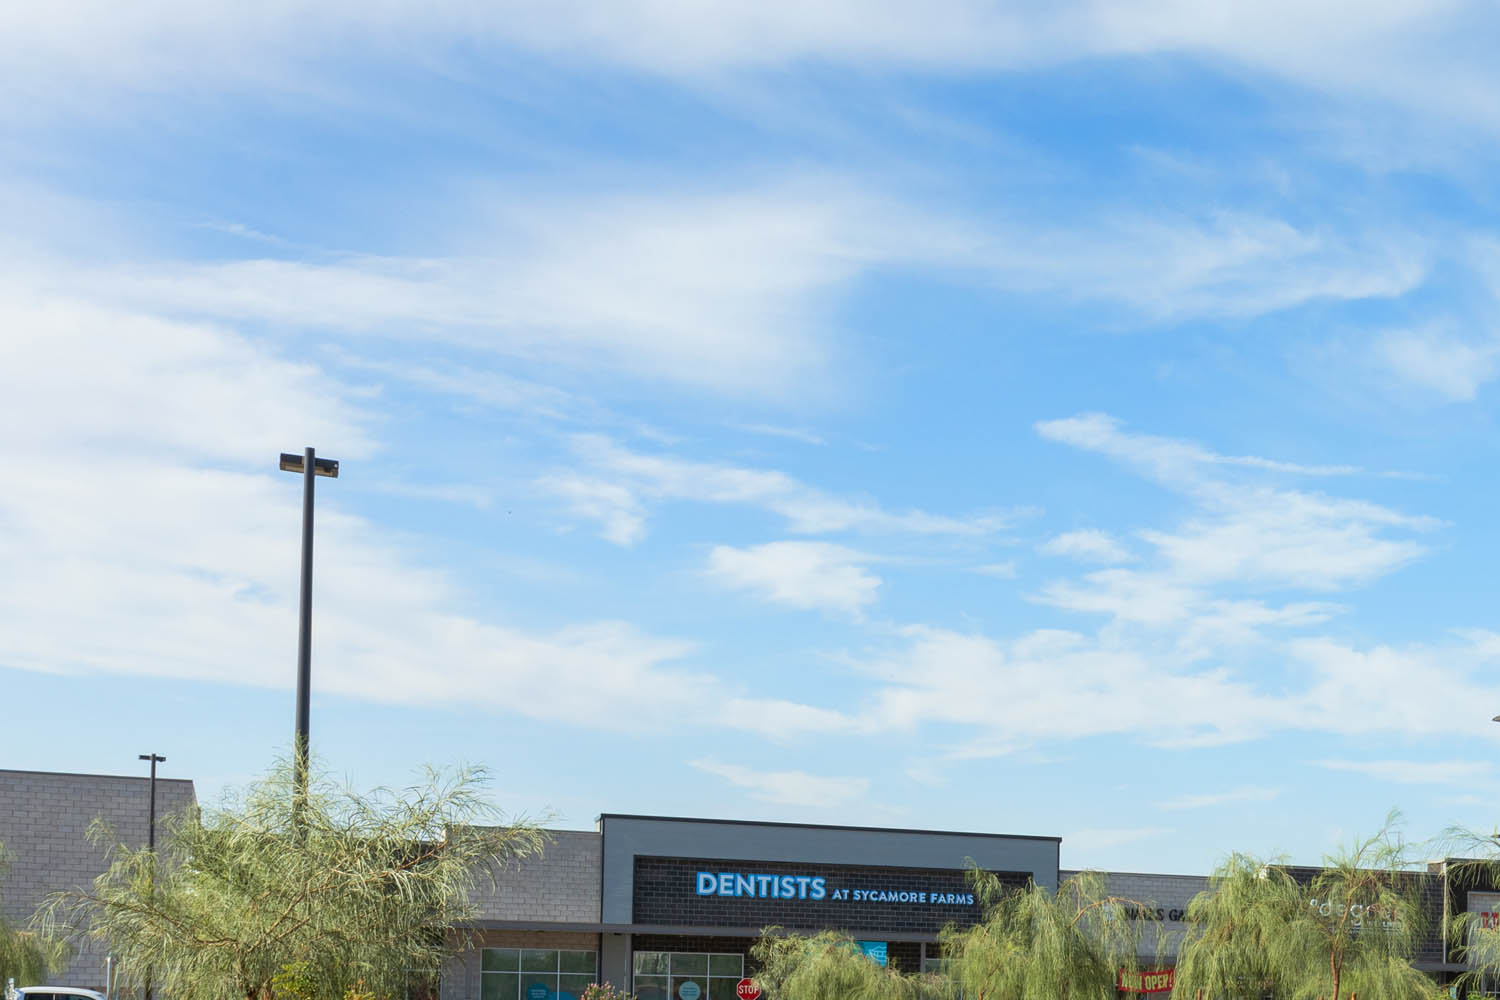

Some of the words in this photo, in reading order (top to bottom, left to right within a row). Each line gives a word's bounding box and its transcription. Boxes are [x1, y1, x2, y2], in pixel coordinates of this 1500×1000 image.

[697, 872, 826, 900] DENTISTS
[832, 890, 848, 900] AT
[853, 890, 926, 903] SYCAMORE
[930, 893, 974, 905] FARMS
[738, 984, 758, 995] STOP
